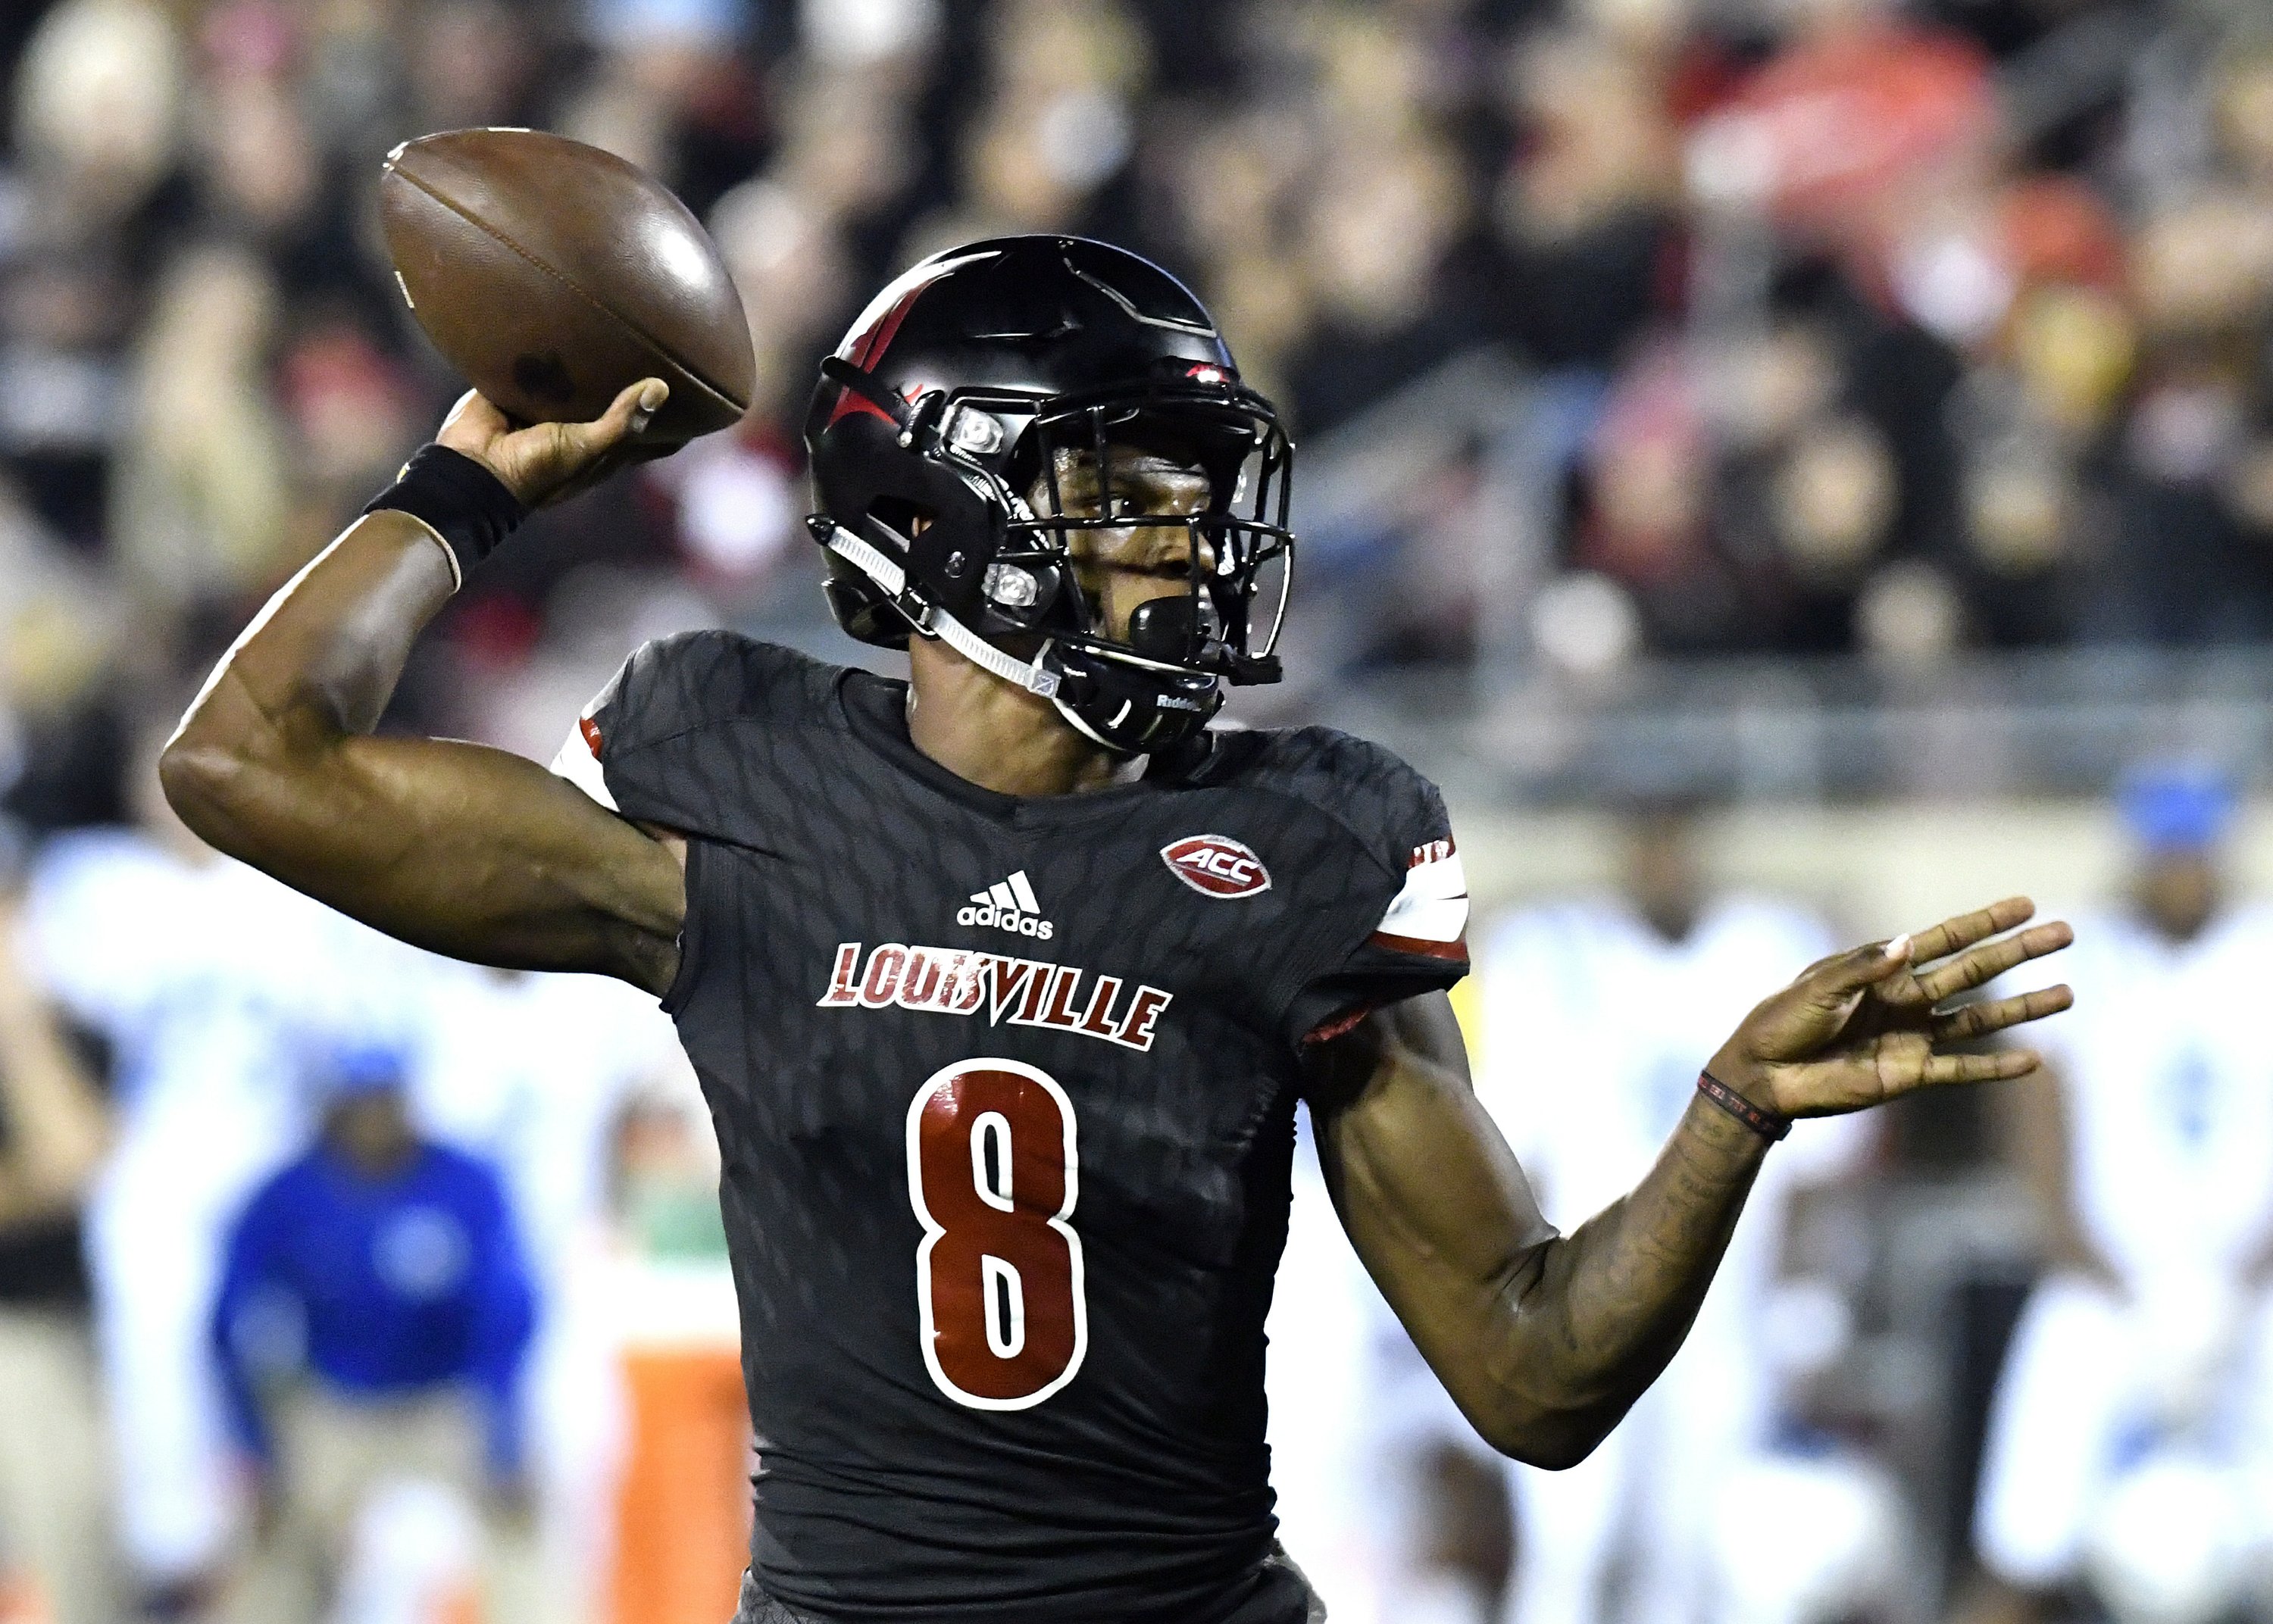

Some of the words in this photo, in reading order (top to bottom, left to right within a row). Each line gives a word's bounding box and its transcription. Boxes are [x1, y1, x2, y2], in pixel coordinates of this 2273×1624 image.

[1176, 848, 1259, 882] ACC
[956, 903, 1054, 940] adidas
[816, 942, 1174, 1052] LOUISVILLE
[906, 1057, 1088, 1411] 8
